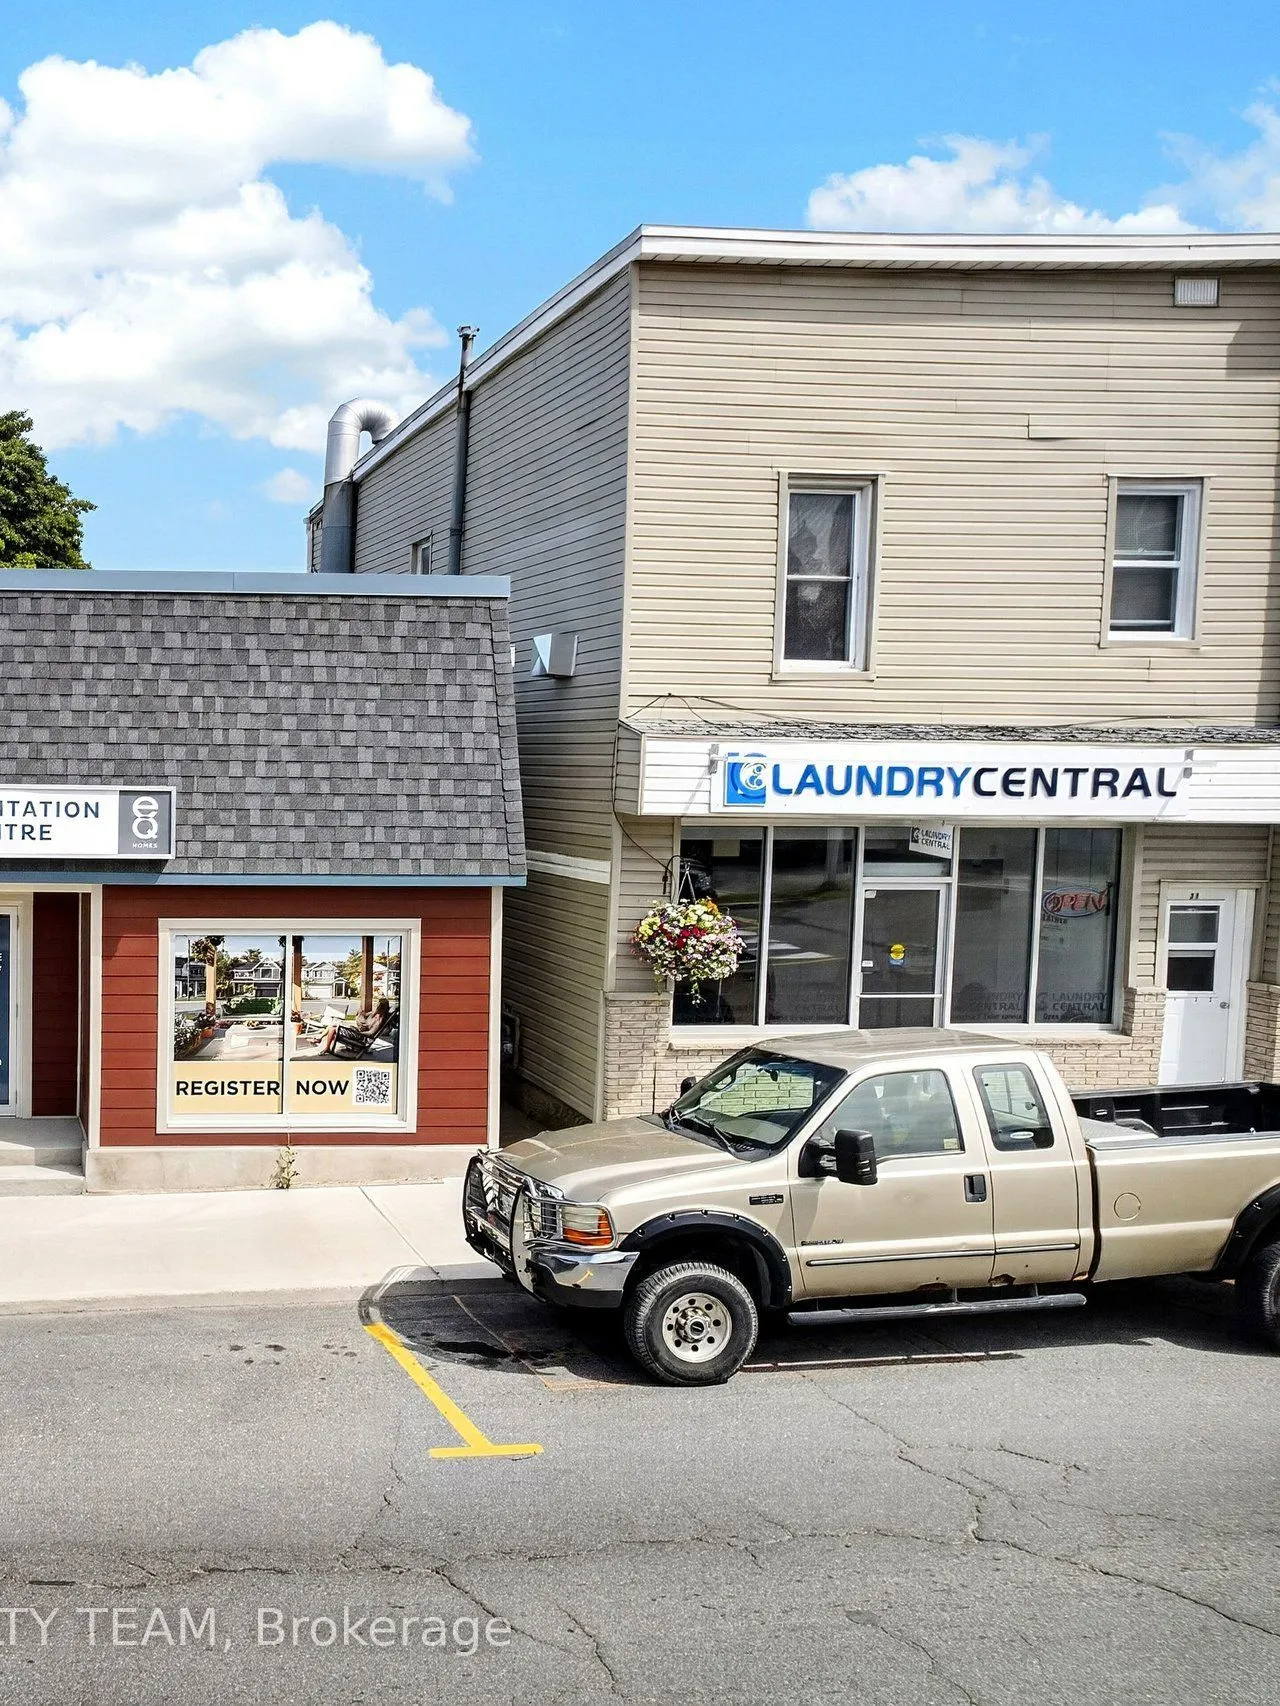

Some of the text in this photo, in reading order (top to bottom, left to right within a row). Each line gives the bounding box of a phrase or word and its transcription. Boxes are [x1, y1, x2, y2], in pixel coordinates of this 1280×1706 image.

[921, 829, 951, 840] LAUNDRY
[921, 838, 951, 850] CENTRAL
[1047, 890, 1107, 913] OPEN
[1052, 992, 1108, 1001] LAUNDRY
[1052, 1002, 1107, 1012] CENTRAL
[176, 1080, 350, 1096] REGISTER NOW
